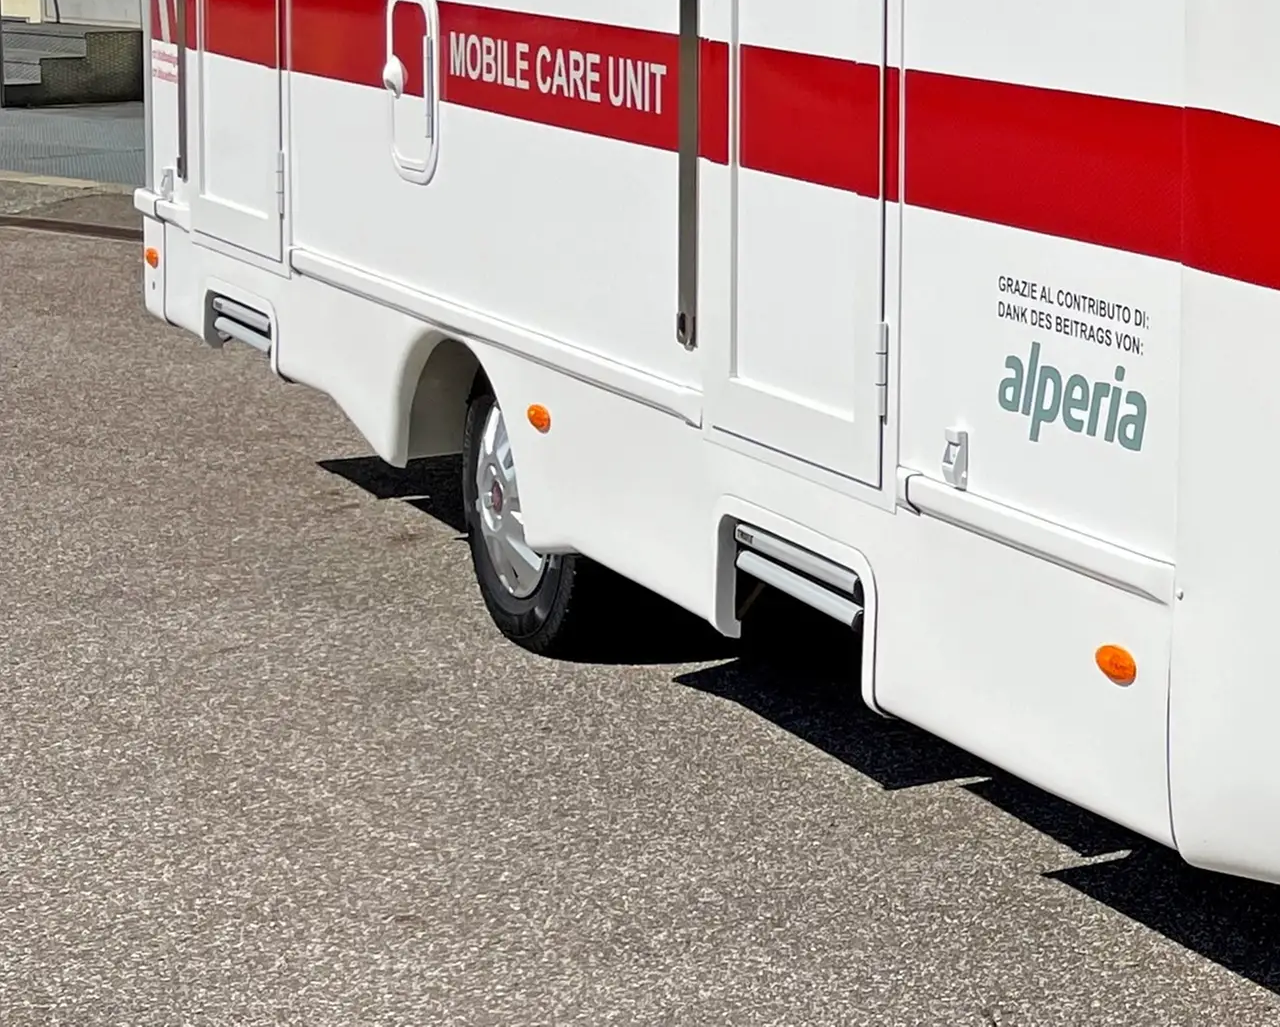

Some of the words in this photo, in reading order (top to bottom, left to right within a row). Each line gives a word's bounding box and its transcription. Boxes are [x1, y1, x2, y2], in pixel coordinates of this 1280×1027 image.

[449, 30, 529, 91] MOBILE
[535, 45, 601, 103] CARE
[608, 56, 667, 115] UNIT
[998, 275, 1038, 301] GRAZIE
[1040, 285, 1054, 305] AL
[1056, 289, 1132, 324] CONTRIBUTO
[1134, 308, 1150, 330] DI:
[998, 300, 1028, 325] DANK
[1031, 309, 1052, 330] DES
[1055, 315, 1113, 348] BEITRAGS
[1114, 330, 1144, 356] VON:
[998, 341, 1148, 452] alperia
